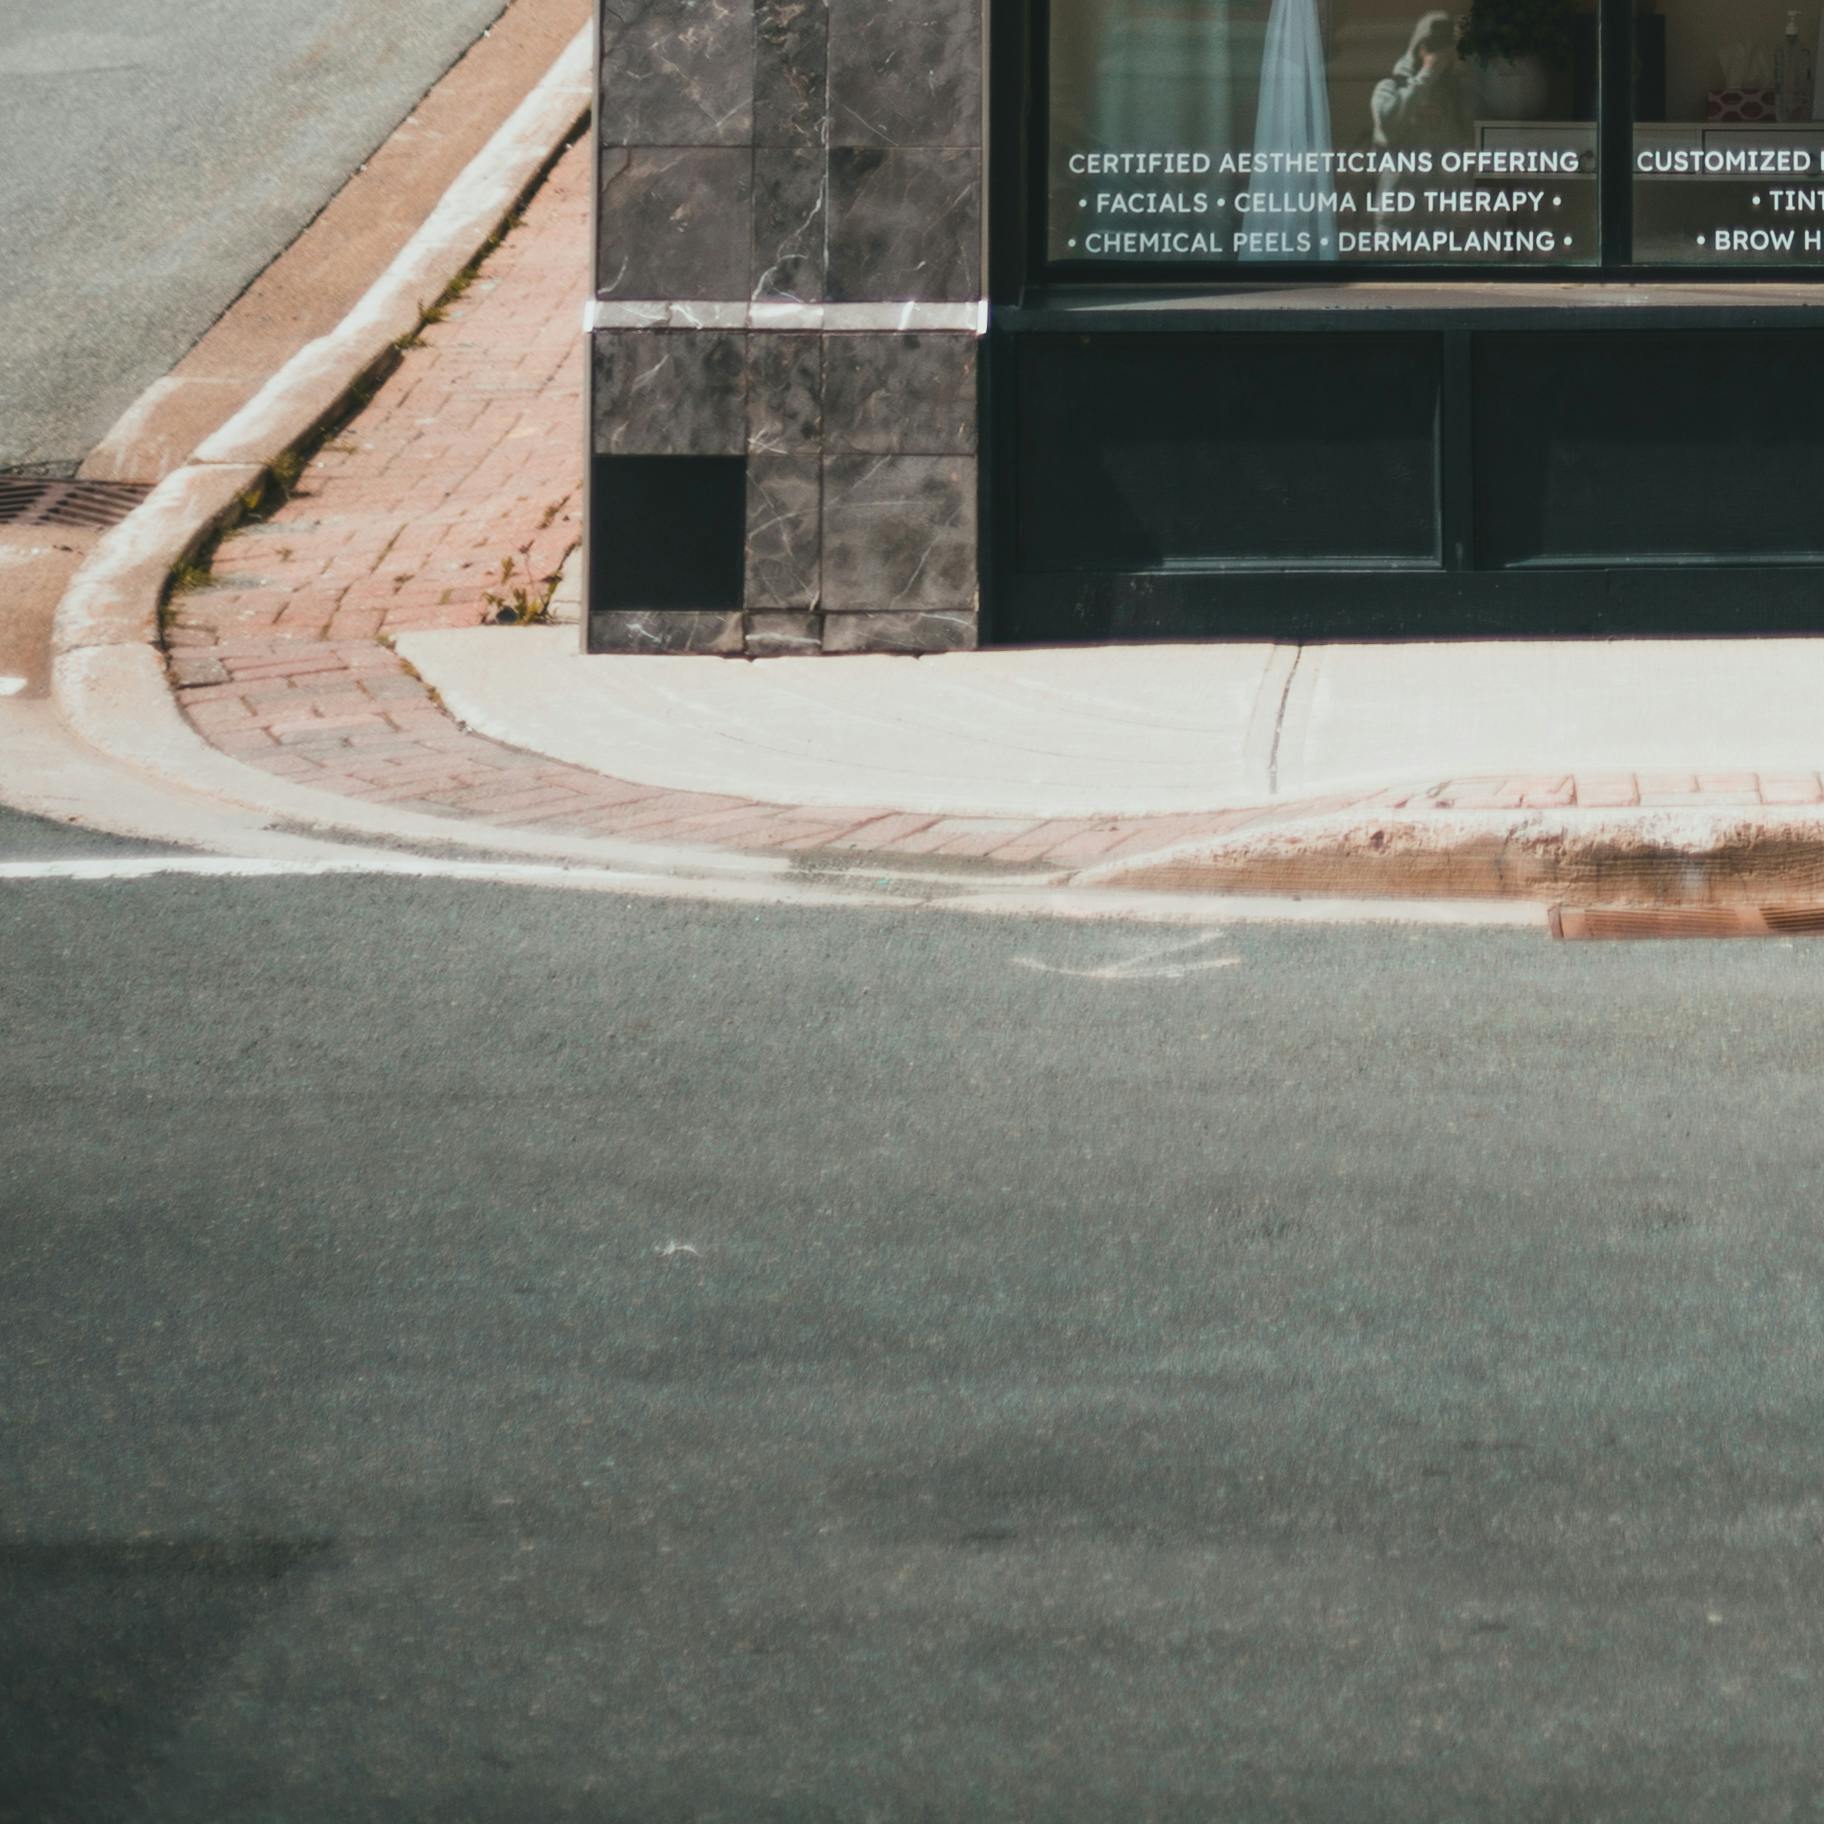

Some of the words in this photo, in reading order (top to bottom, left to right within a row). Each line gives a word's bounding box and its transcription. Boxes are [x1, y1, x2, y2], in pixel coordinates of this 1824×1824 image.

[1068, 153, 1211, 174] CERTIFIED
[1218, 152, 1433, 173] AESTHETICIANS
[1441, 151, 1579, 173] OFFERING
[1637, 151, 1811, 172] CUSTOMIZED
[1097, 193, 1208, 213] FACIALS
[1234, 192, 1357, 213] CELLUMA
[1366, 192, 1416, 212] LED
[1423, 191, 1545, 212] THERAPY
[1085, 232, 1223, 253] CHEMICAL
[1234, 232, 1311, 252] PEELS
[1338, 231, 1555, 252] DERMAPLANING
[1715, 230, 1795, 251] BROW
